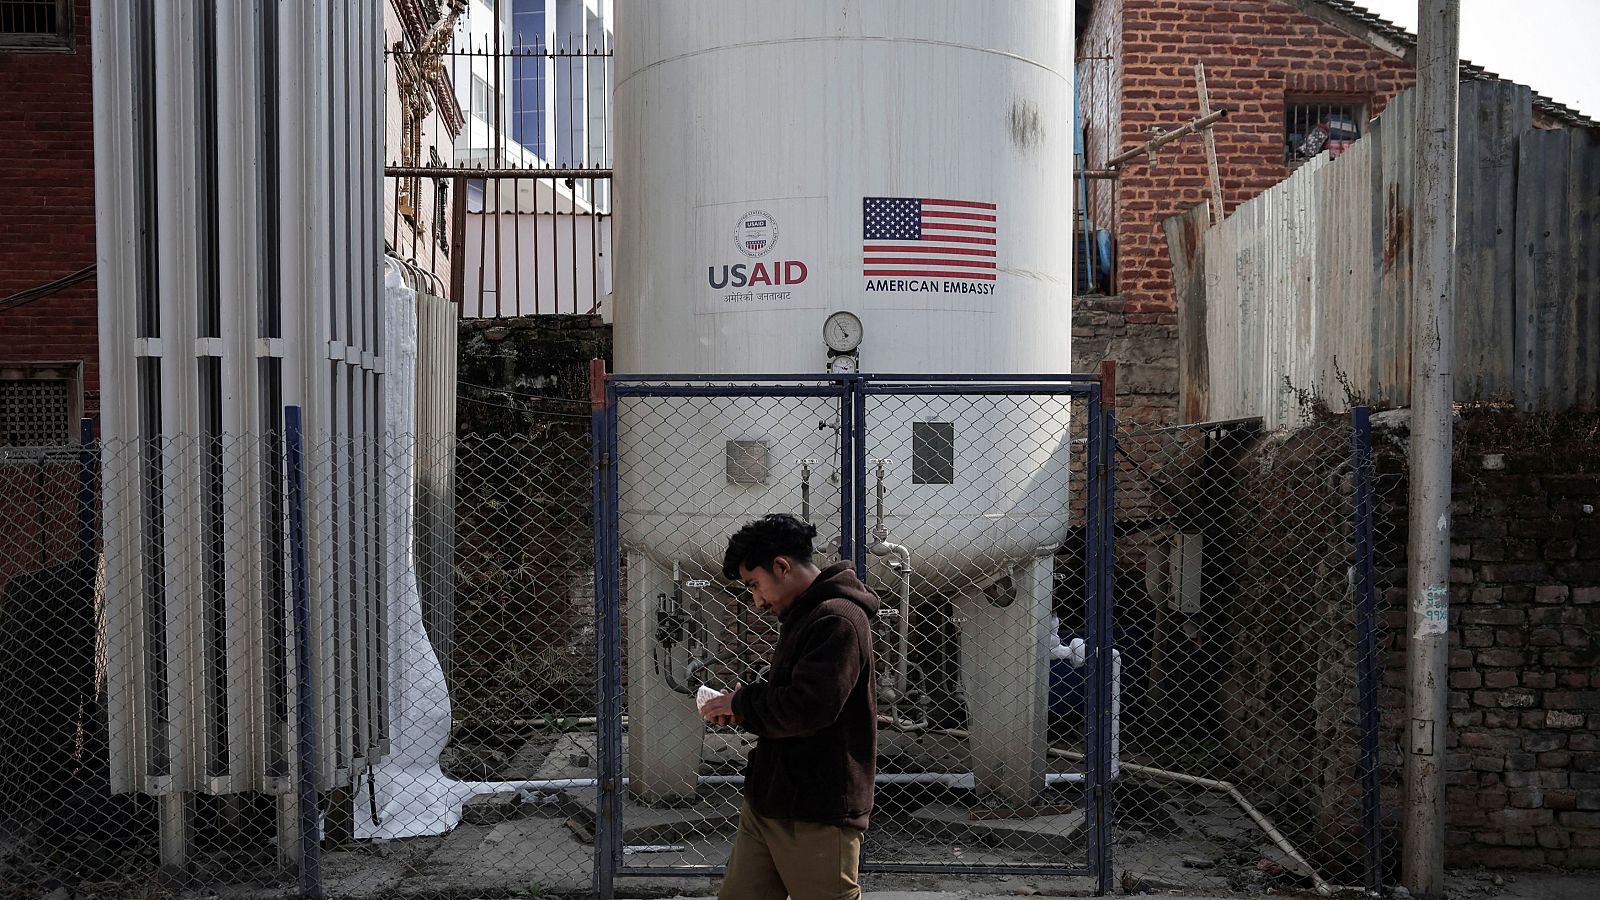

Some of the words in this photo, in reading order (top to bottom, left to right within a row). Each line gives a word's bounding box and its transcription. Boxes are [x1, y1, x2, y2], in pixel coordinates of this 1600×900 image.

[708, 260, 808, 289] USAID
[865, 279, 939, 293] AMERICAN
[943, 281, 996, 295] EMBASSY
[723, 291, 753, 303] अमेरिकी
